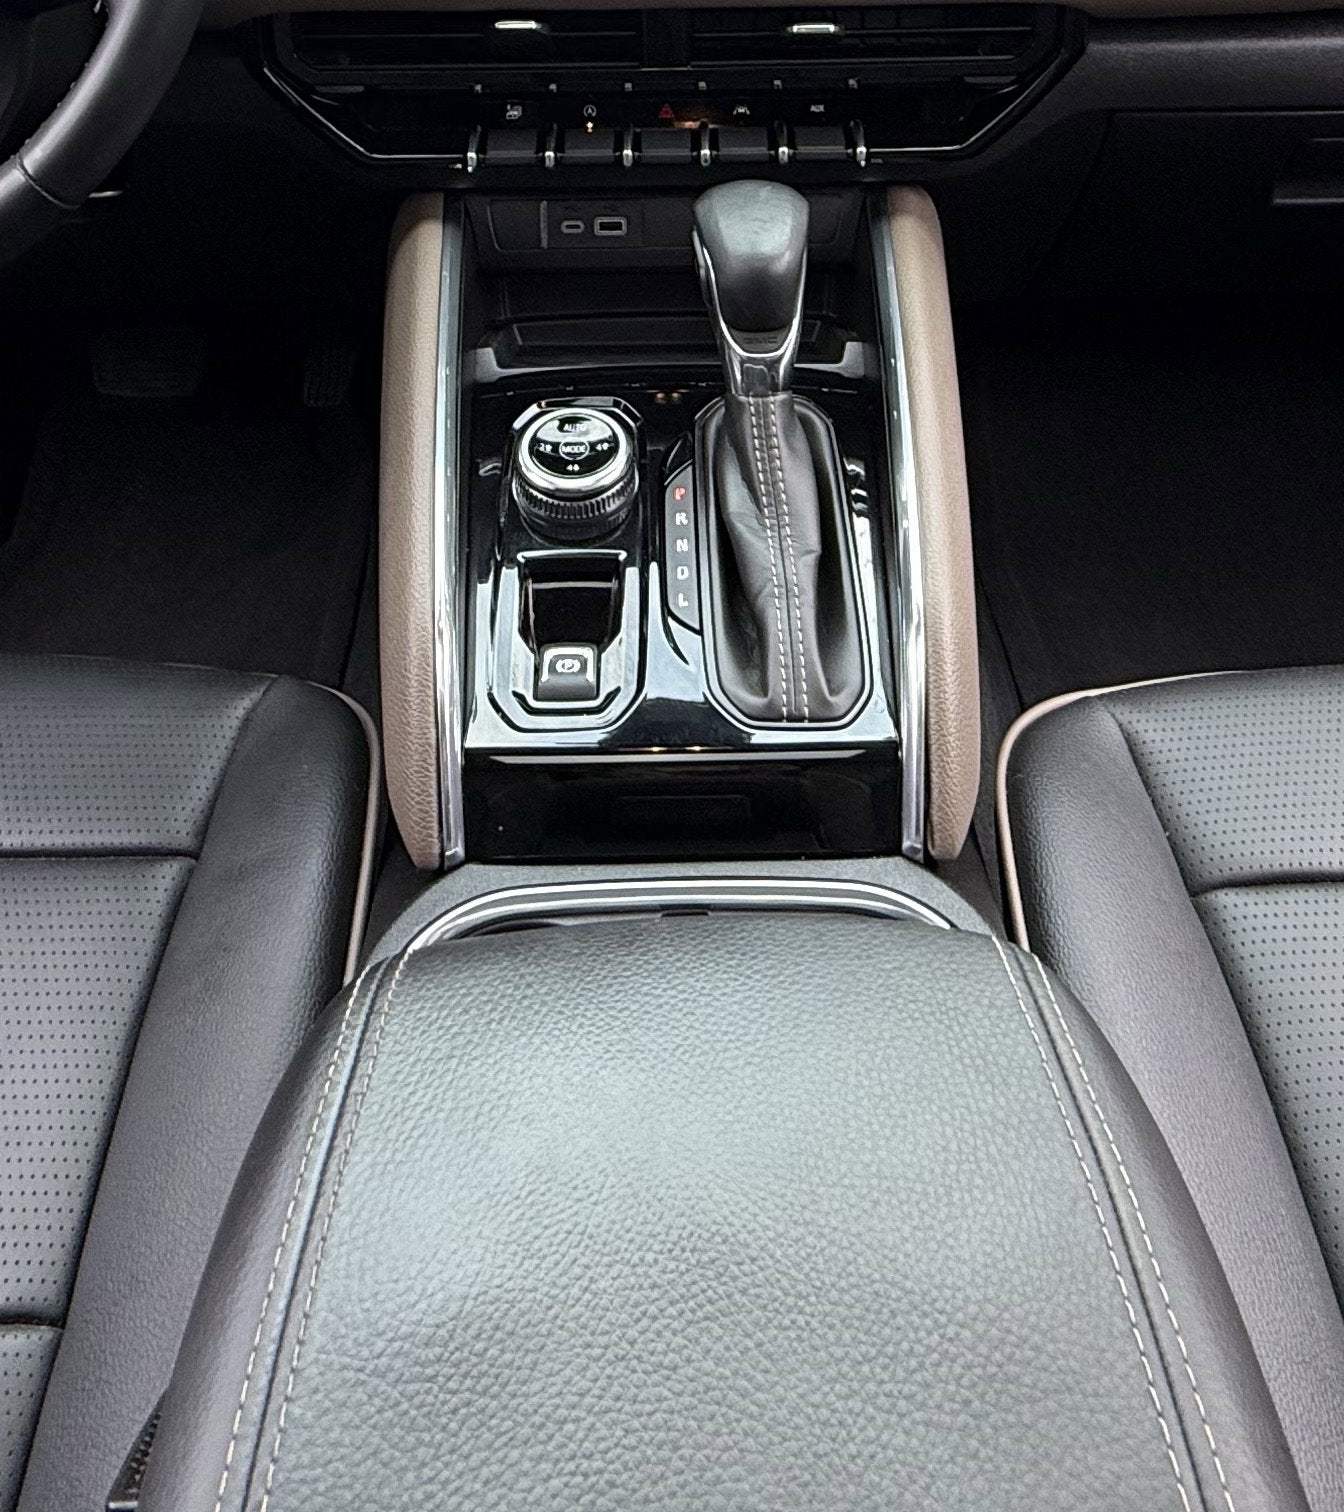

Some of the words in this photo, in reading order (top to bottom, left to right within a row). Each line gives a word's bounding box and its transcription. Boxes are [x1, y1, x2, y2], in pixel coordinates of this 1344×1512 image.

[562, 422, 588, 433] AUTO
[561, 444, 587, 454] MODE
[674, 486, 687, 501] P
[675, 511, 689, 526] R
[676, 538, 689, 553] N
[676, 565, 689, 581] D
[677, 592, 689, 608] L
